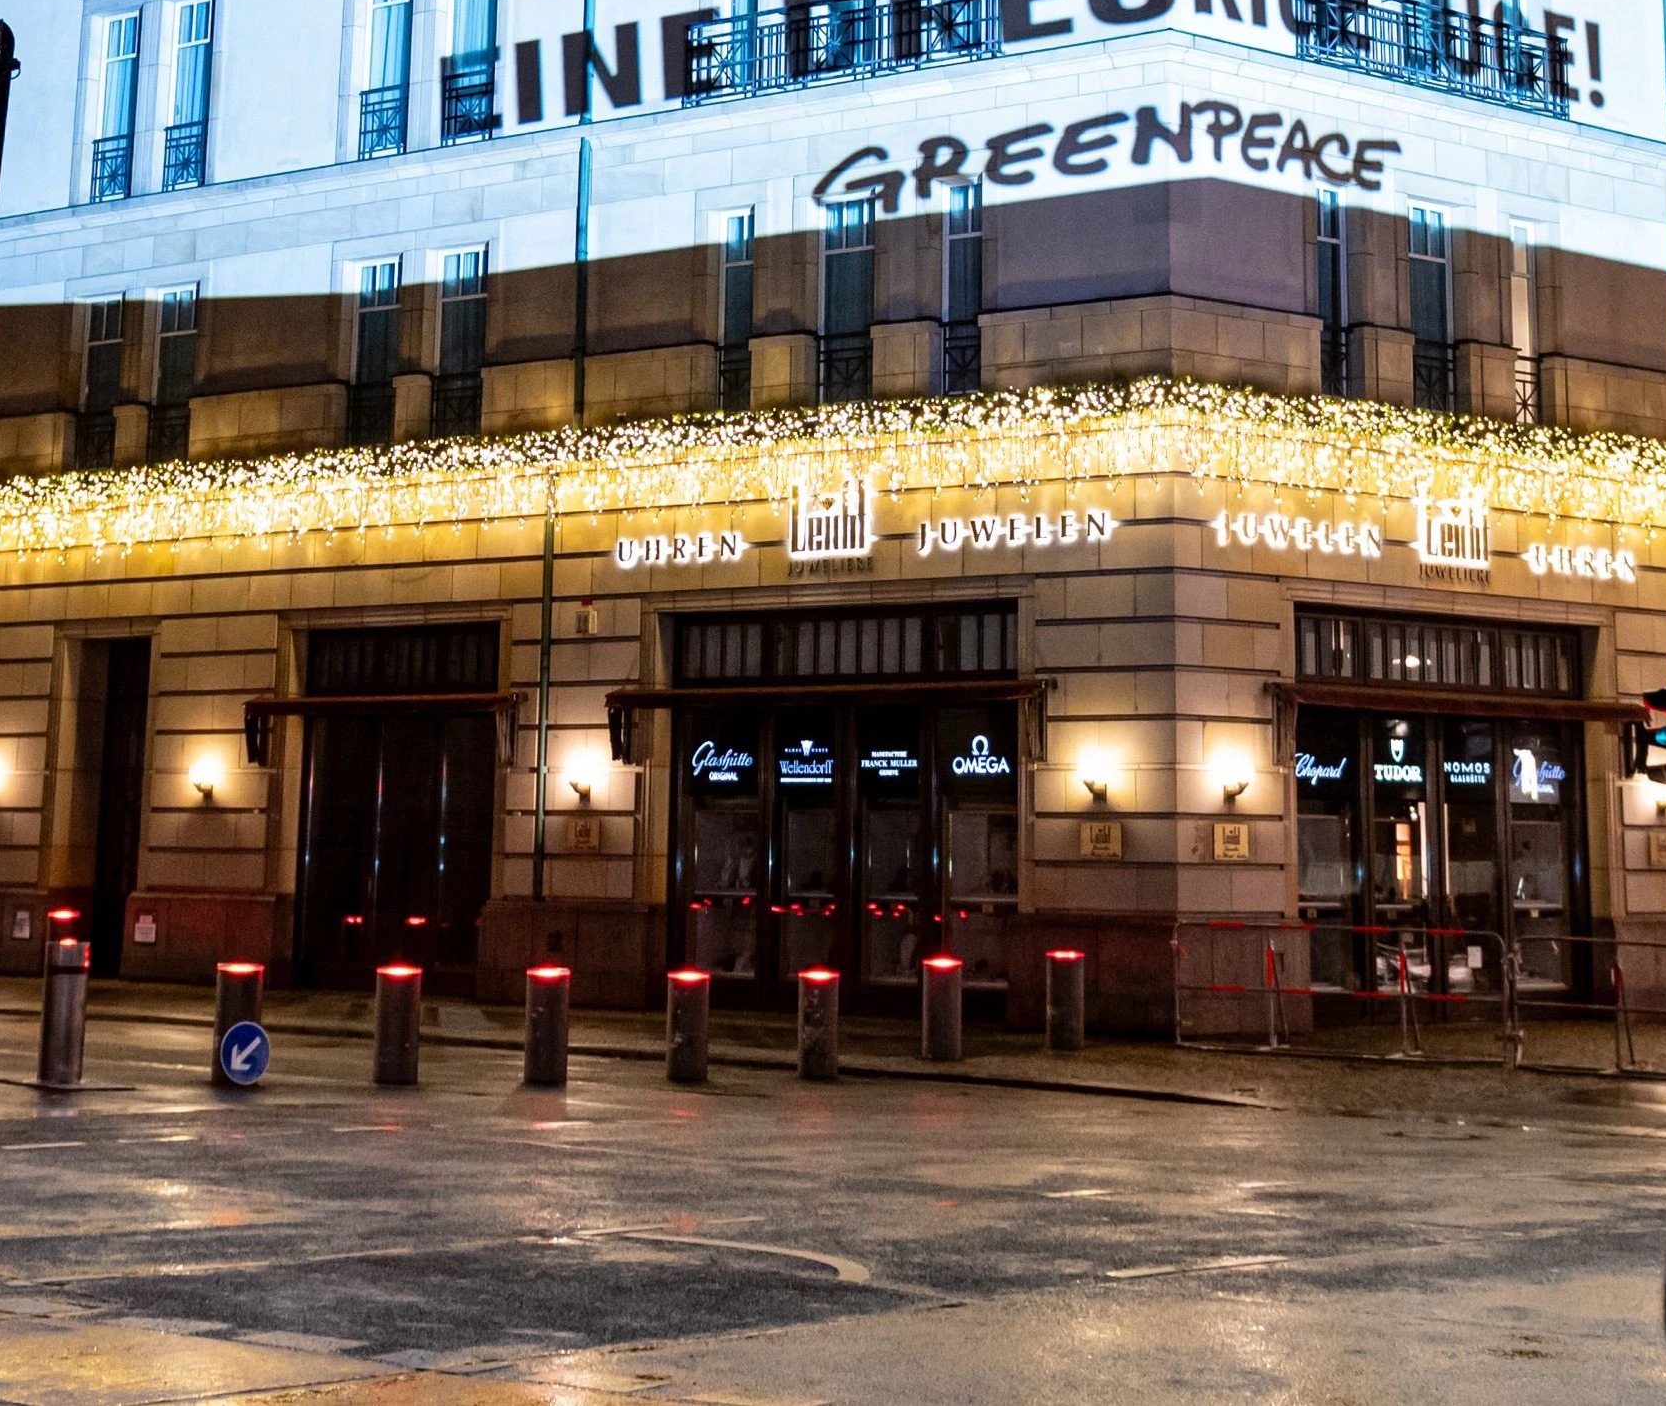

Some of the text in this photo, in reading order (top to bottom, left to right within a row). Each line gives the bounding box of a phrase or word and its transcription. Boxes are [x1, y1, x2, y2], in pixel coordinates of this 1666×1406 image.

[810, 100, 1402, 214] GREENPEACE
[917, 512, 1106, 552] JUWELEN
[1218, 512, 1382, 557] JUWELEN
[618, 534, 737, 562] UHREN
[779, 759, 834, 775] Wellendorff
[861, 759, 918, 768] FRANCK MULLER
[952, 756, 1010, 775] OMEGA
[1294, 752, 1347, 786] Chopard
[1374, 764, 1423, 782] TUDOR
[1443, 761, 1491, 775] NOMOS
